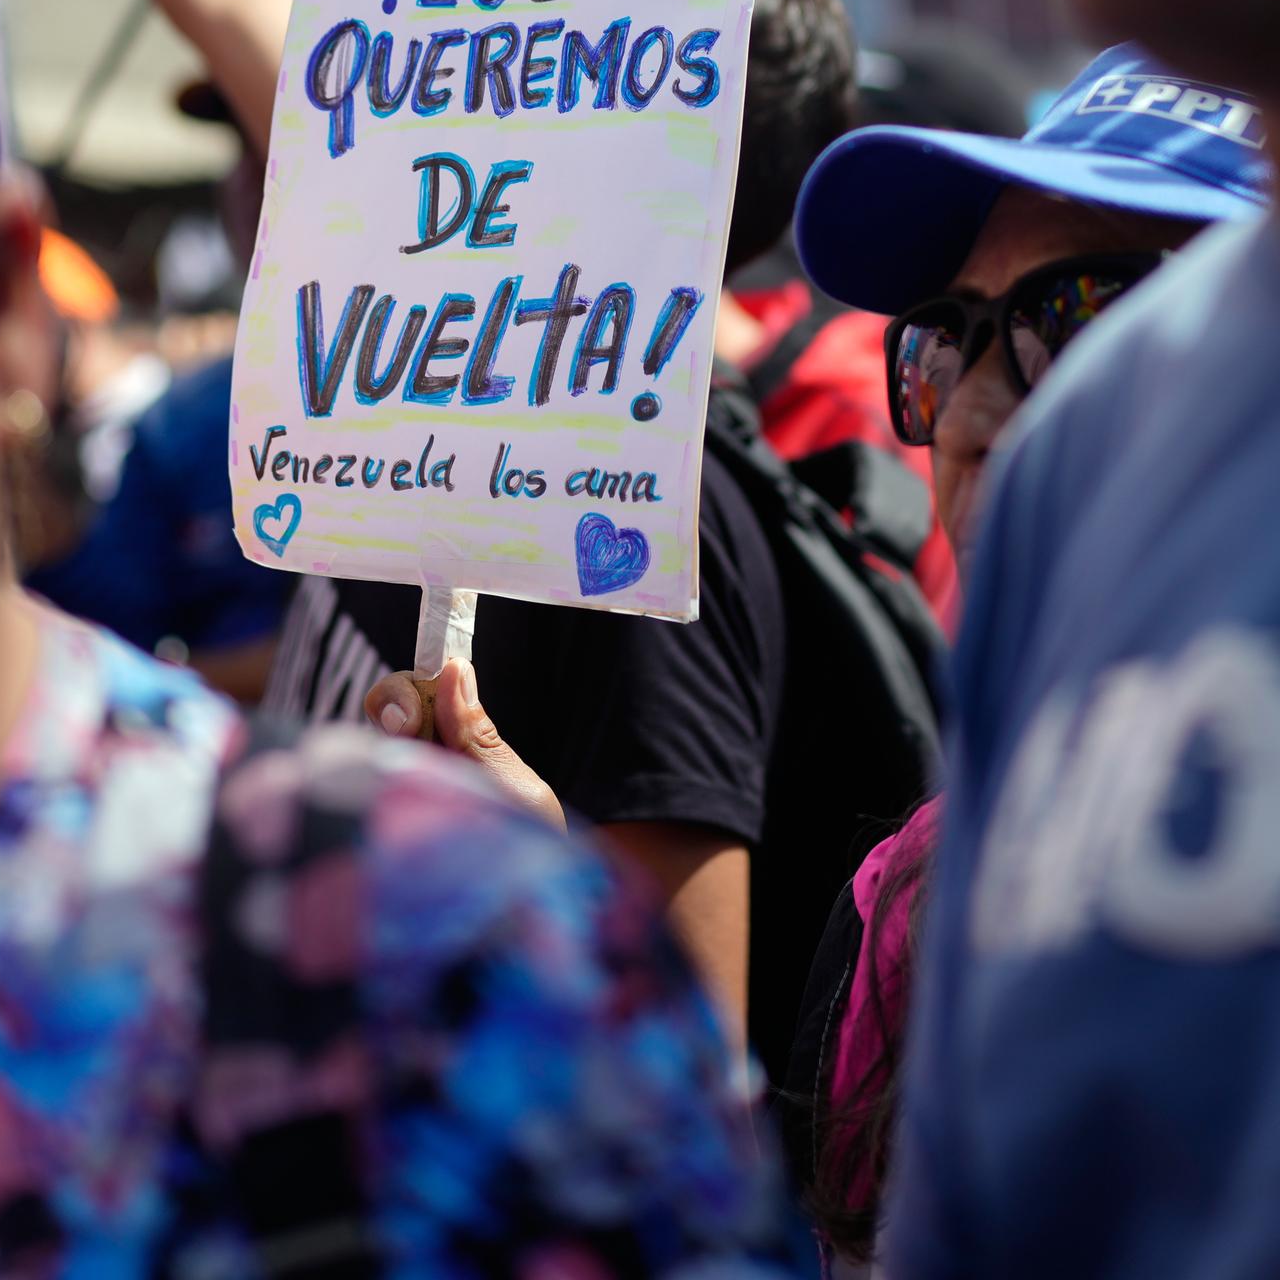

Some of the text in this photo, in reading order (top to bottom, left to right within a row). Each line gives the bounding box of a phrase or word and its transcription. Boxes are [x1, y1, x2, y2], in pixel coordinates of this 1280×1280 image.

[305, 16, 720, 158] QUEREMOS
[1128, 81, 1264, 138] PPT
[399, 151, 535, 255] DE
[249, 425, 662, 504] Venezuela los ama
